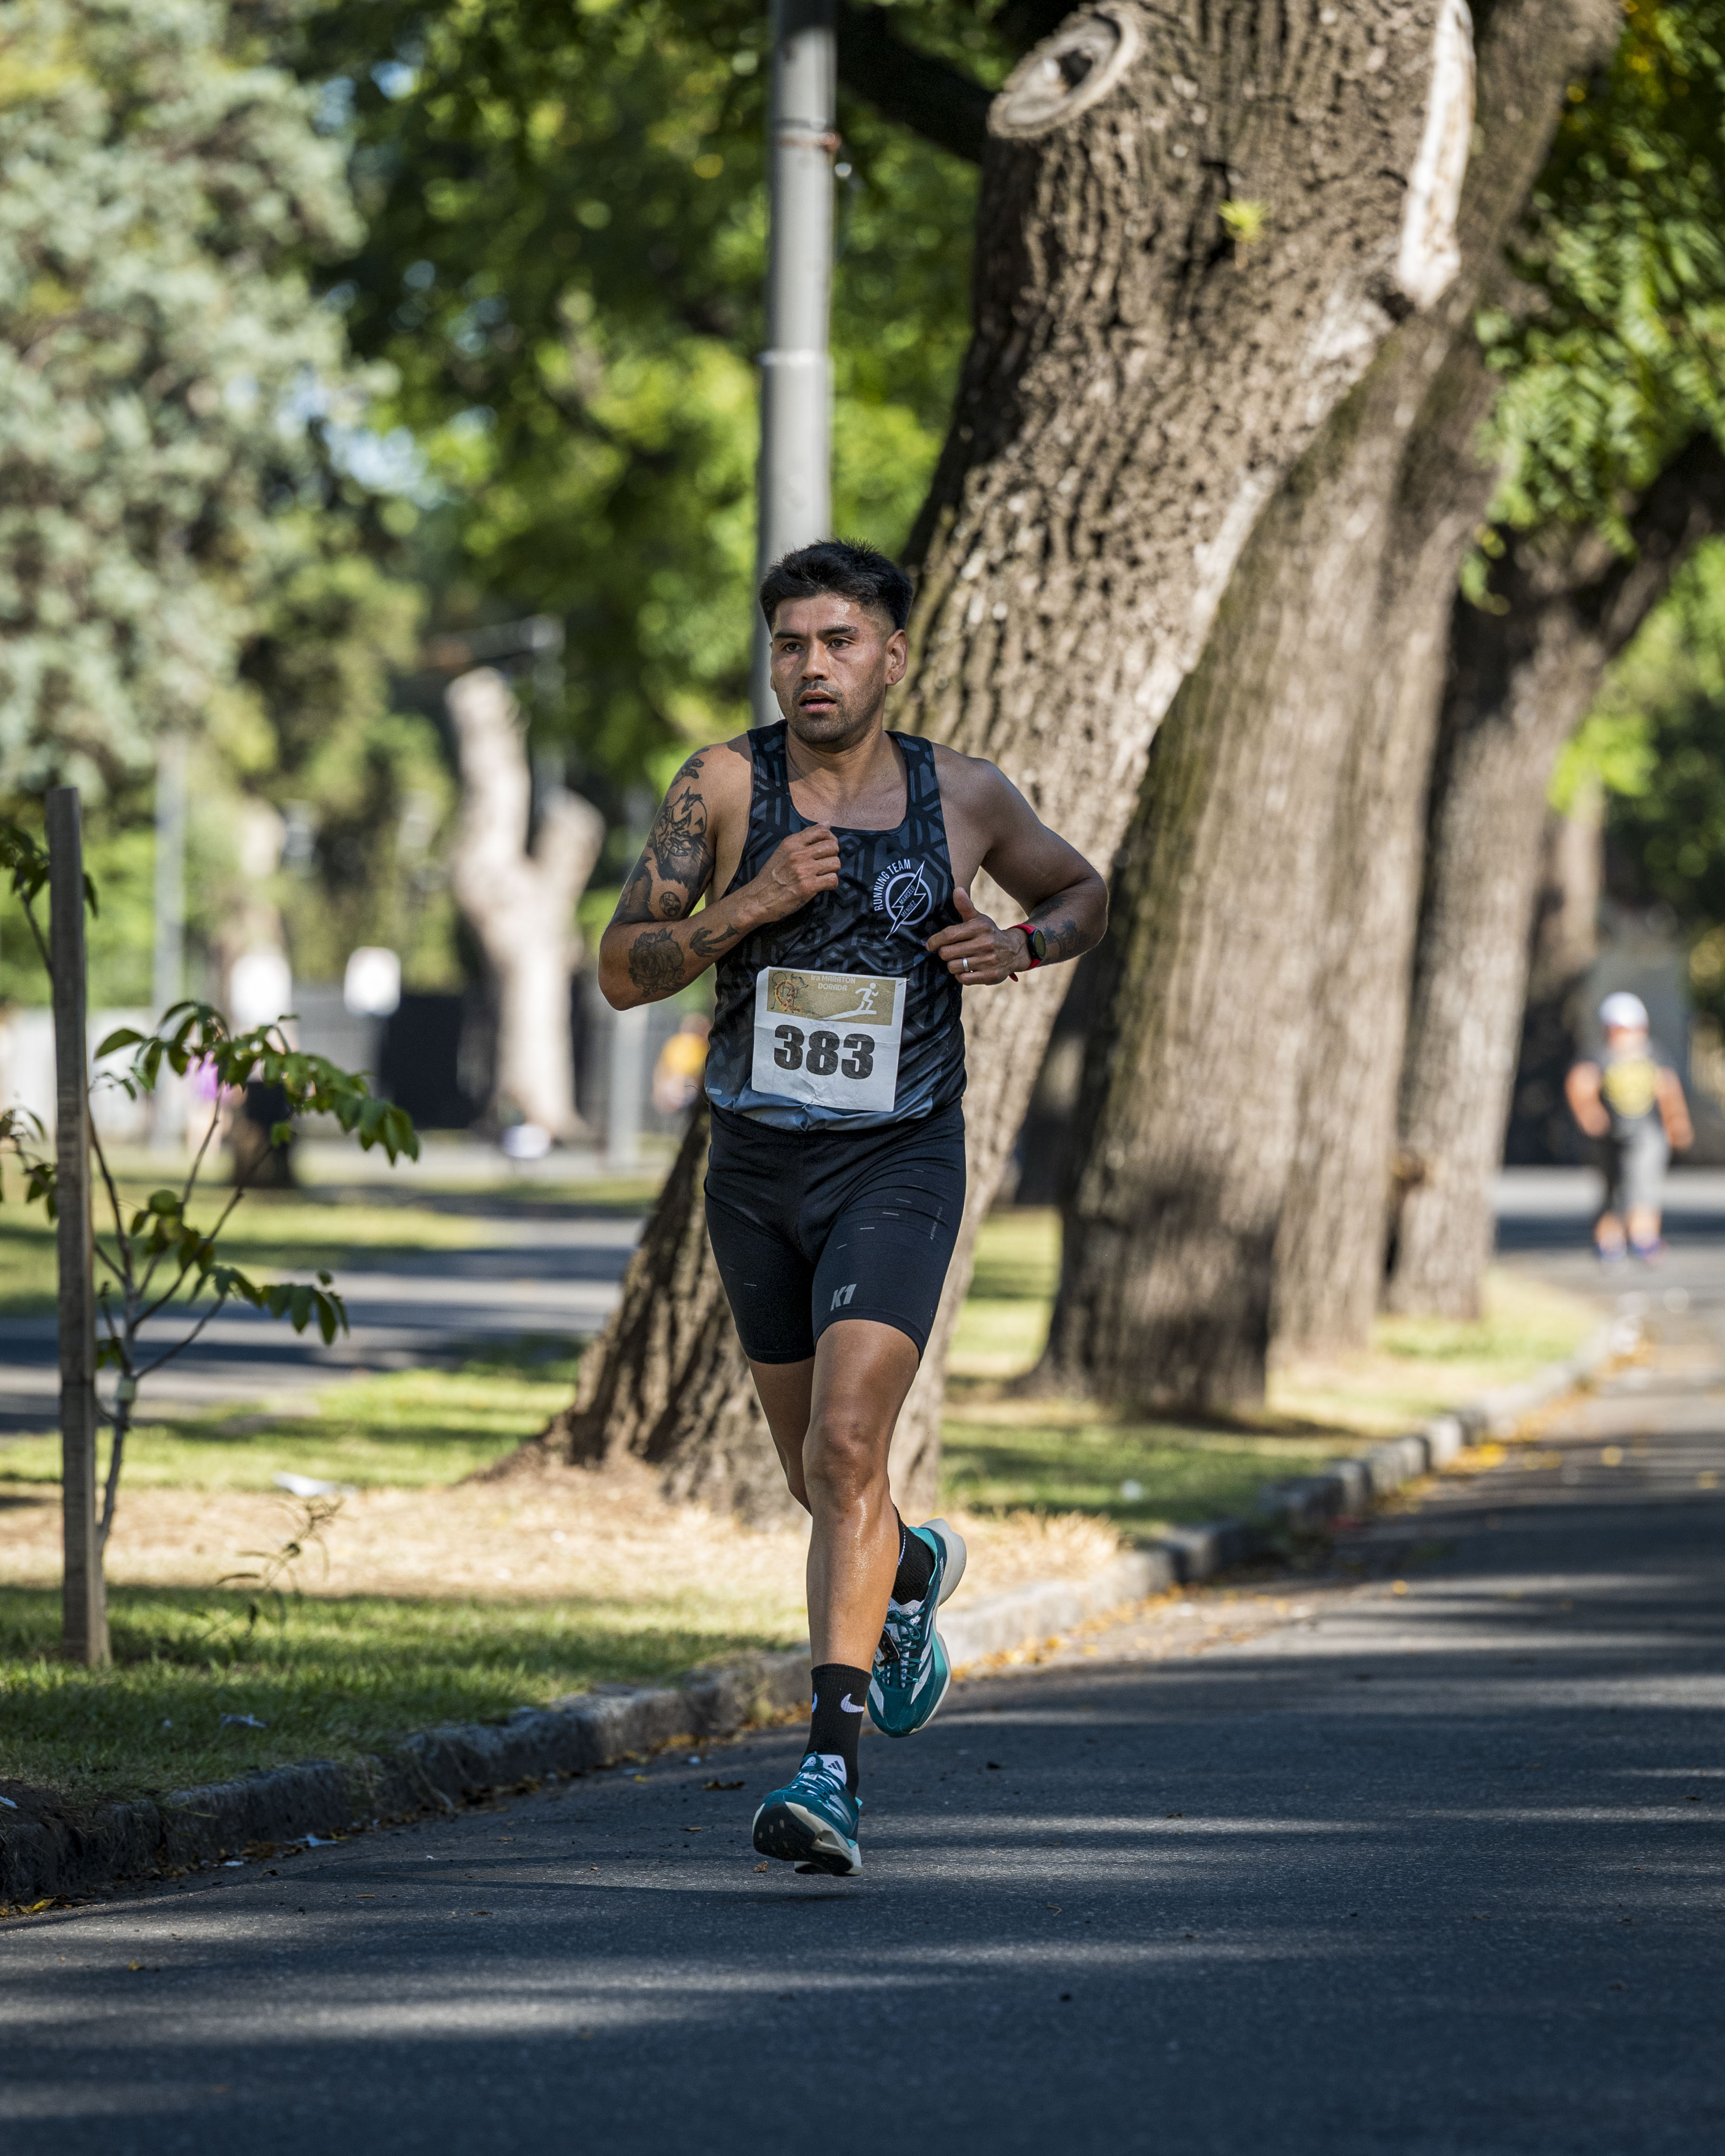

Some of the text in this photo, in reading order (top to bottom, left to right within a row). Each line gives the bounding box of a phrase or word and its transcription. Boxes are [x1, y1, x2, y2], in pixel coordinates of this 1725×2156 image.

[873, 859, 911, 911] RUNNING TEAM
[899, 885, 915, 905] MARCELO
[901, 900, 916, 918] MENDEZ
[818, 983, 847, 991] DORADA
[822, 975, 856, 984] MARATON
[774, 1024, 875, 1080] 383
[830, 1283, 857, 1311] K1
